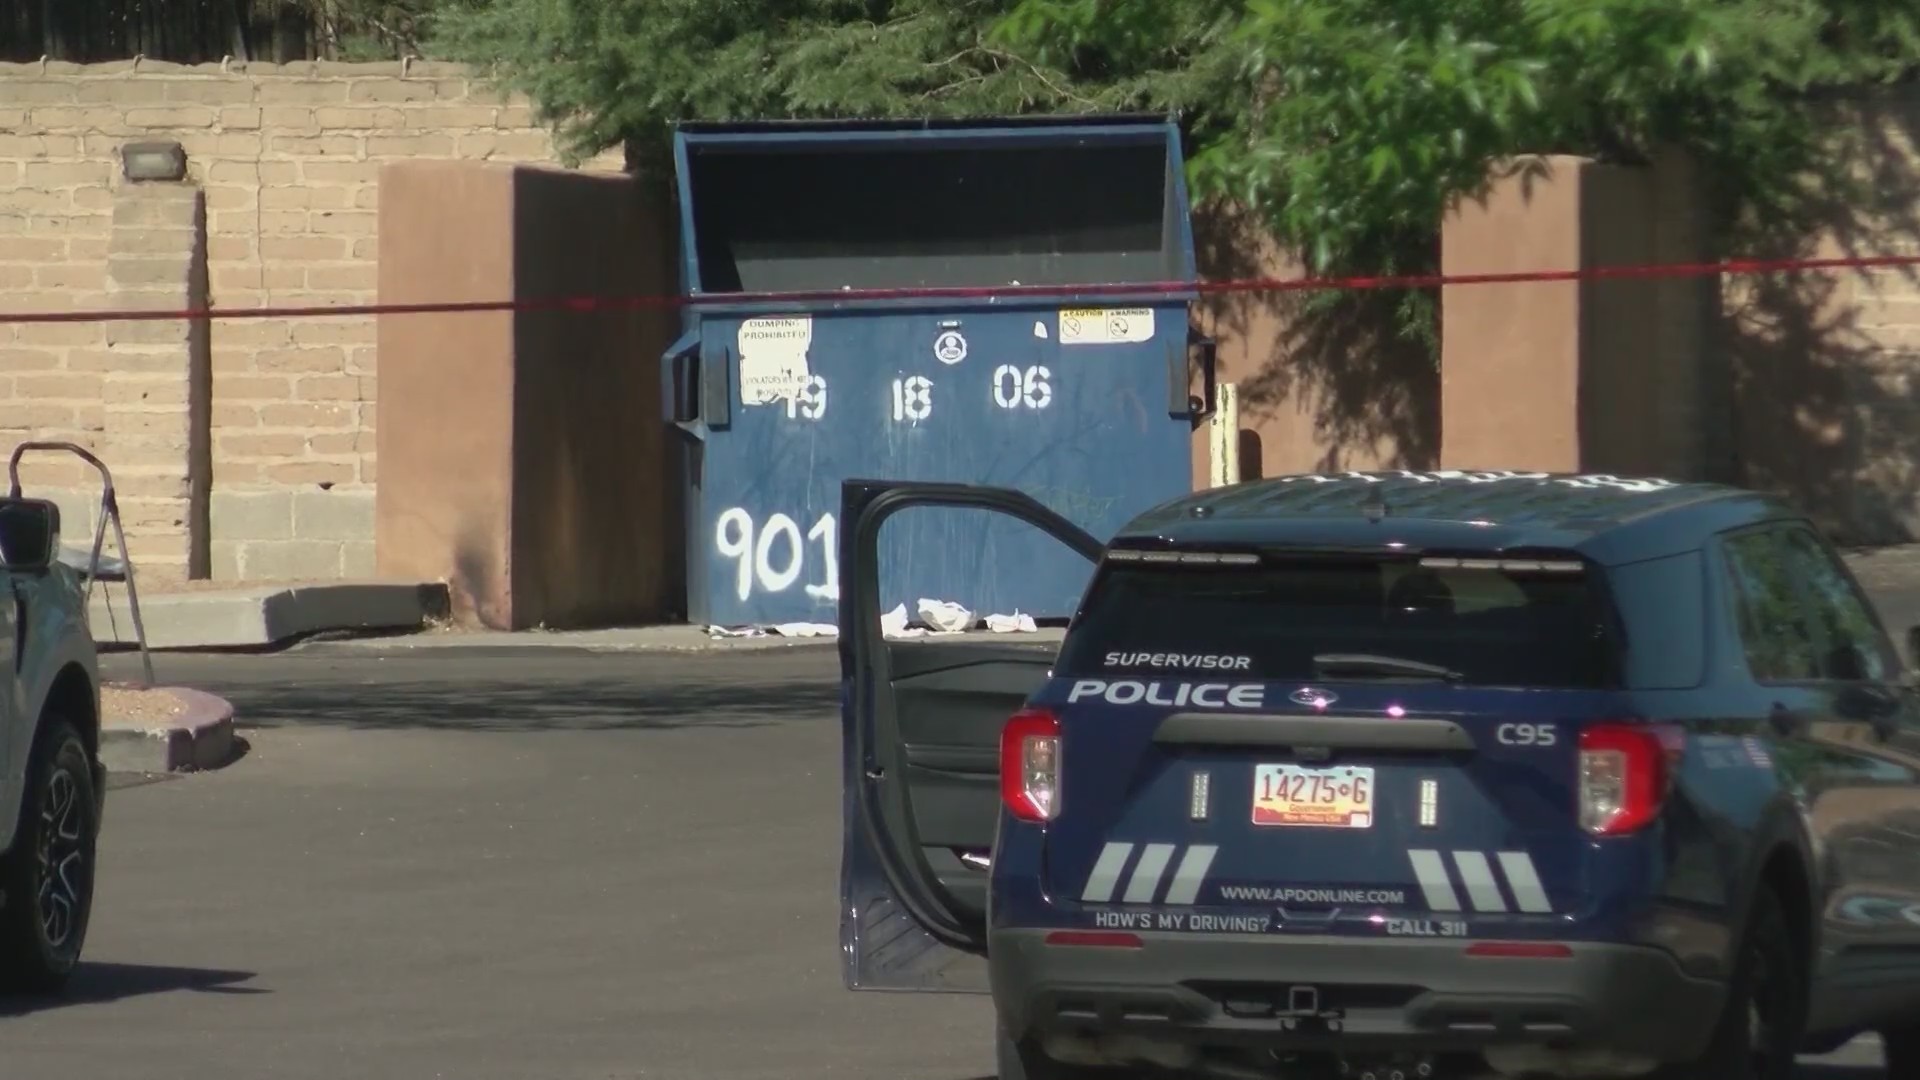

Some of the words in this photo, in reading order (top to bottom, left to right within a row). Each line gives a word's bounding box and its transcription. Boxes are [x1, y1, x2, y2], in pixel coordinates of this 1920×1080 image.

[743, 331, 806, 340] PROHIBITED
[893, 376, 932, 420] 18
[993, 364, 1052, 409] 06
[716, 507, 840, 601] 901
[1104, 652, 1250, 670] SUPERVISOR
[1067, 680, 1265, 708] POLICE
[1498, 723, 1557, 746] C95
[1220, 886, 1404, 904] WWW.APDONLINE.COM
[1096, 912, 1151, 928] HOW'S
[1158, 914, 1184, 930] MY
[1189, 915, 1270, 933] DRIVING?
[1386, 919, 1437, 936] CALL
[1440, 921, 1468, 937] 311
